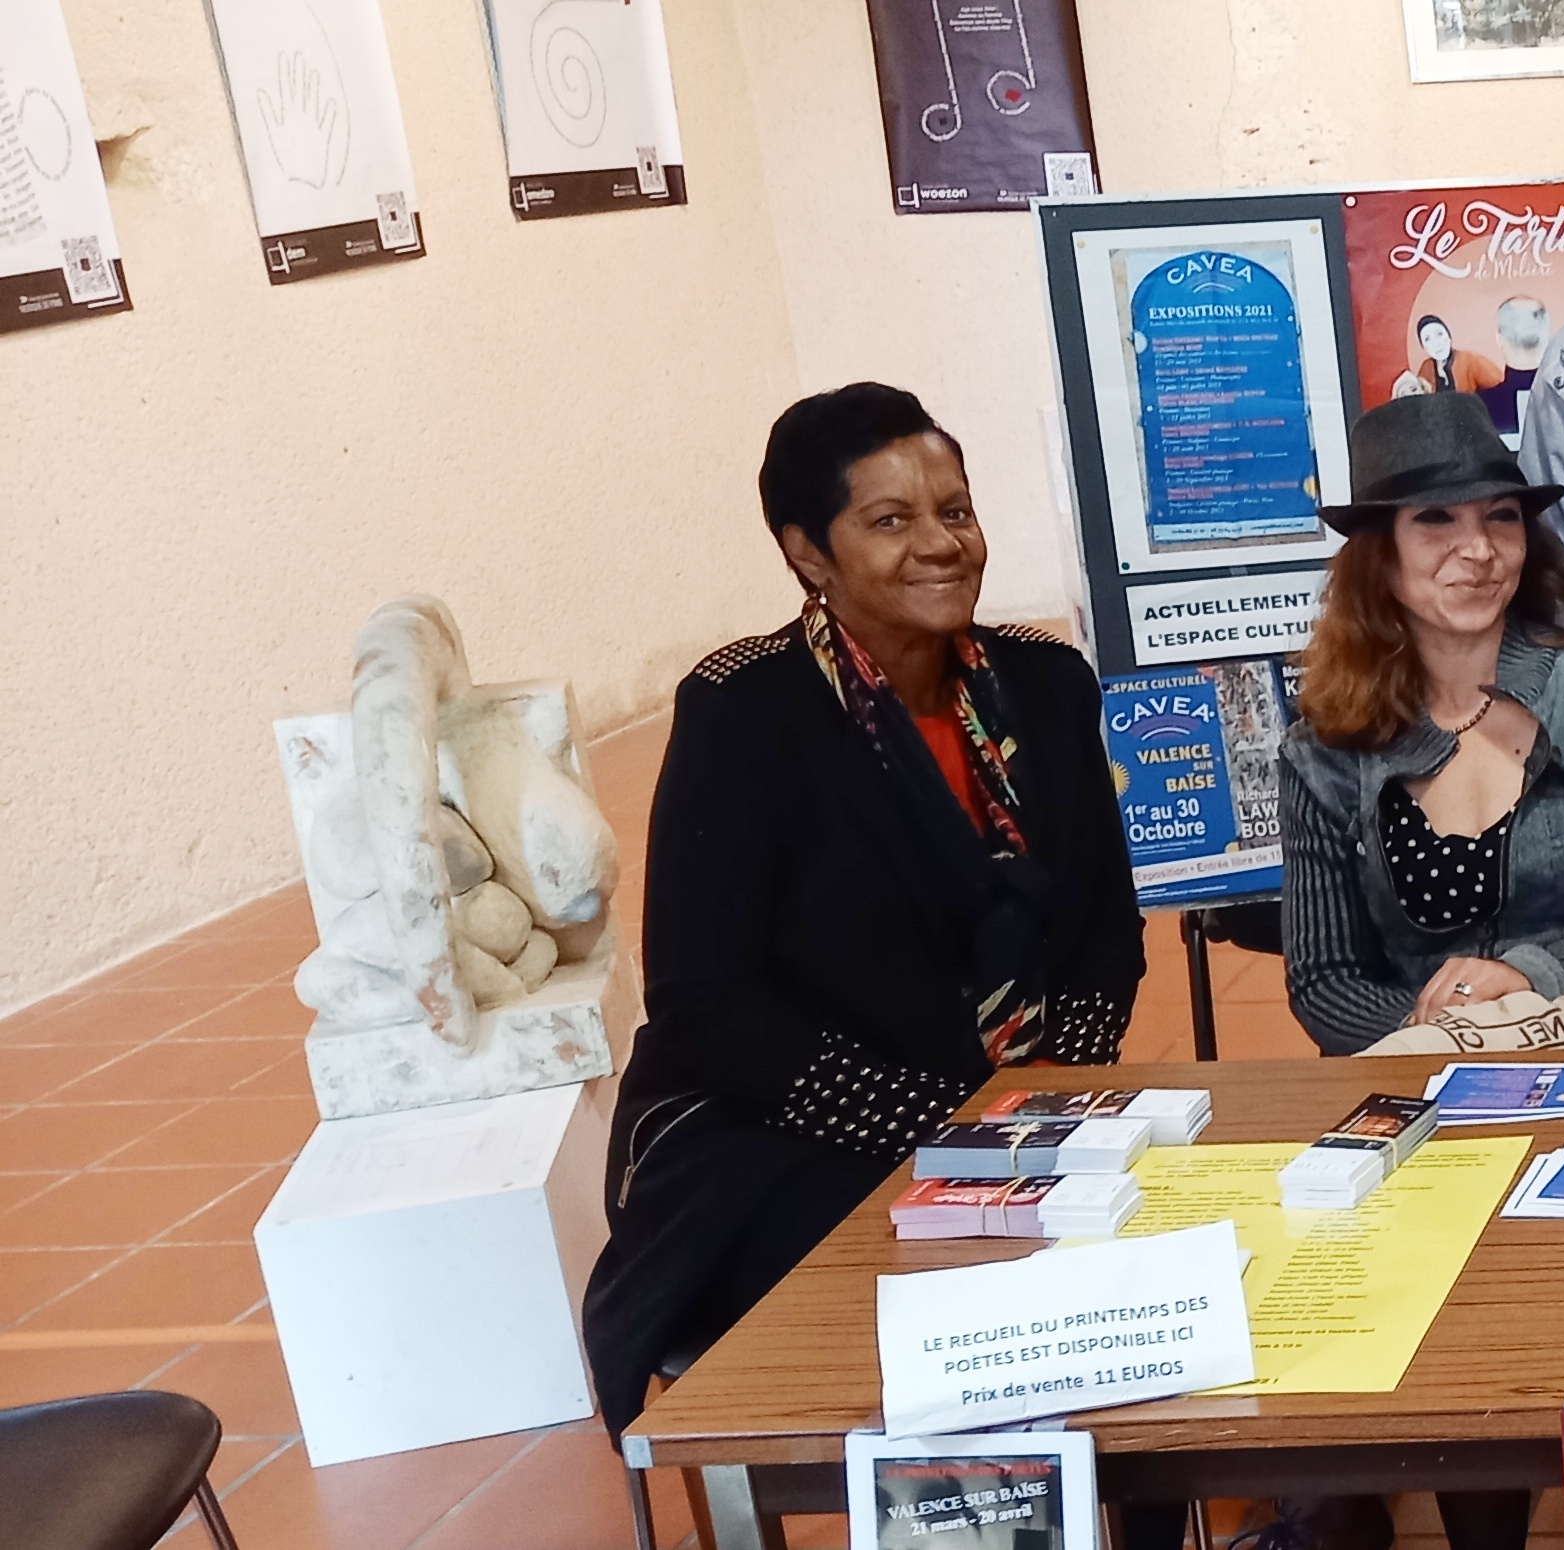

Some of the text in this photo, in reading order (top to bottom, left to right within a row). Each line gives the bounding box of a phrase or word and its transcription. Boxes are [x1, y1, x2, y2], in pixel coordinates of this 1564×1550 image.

[920, 187, 968, 200] woezon
[1389, 201, 1472, 279] Le
[1166, 255, 1252, 285] CAVEA
[1149, 304, 1273, 319] EXPOSITIONS 2021
[1144, 592, 1311, 621] ACTUELLEMENT
[1148, 620, 1315, 648] L'ESPACE CULTU
[1151, 674, 1207, 690] CULTUREL
[1111, 696, 1211, 733] CAVEA
[1136, 743, 1213, 766] VALENCE
[1192, 760, 1214, 772] SUR
[1164, 772, 1217, 793] BAÏSE
[1236, 788, 1280, 803] Richard
[1125, 797, 1200, 824] 1er au 30
[1129, 819, 1206, 843] Octobre
[1134, 866, 1188, 883] Exposition
[923, 1295, 1210, 1353] LE RECUEIL DU PRINTEMPS DES
[944, 1325, 1195, 1375] POÈTES EST DISPONIBLE ICI
[962, 1360, 1184, 1405] Prix de vente 11 EUROS
[886, 1495, 964, 1520] VALENCE
[963, 1490, 999, 1508] SUR
[910, 1521, 926, 1537] 21
[930, 1517, 968, 1533] mars
[977, 1509, 997, 1526] 20
[998, 1502, 1034, 1522] avril
